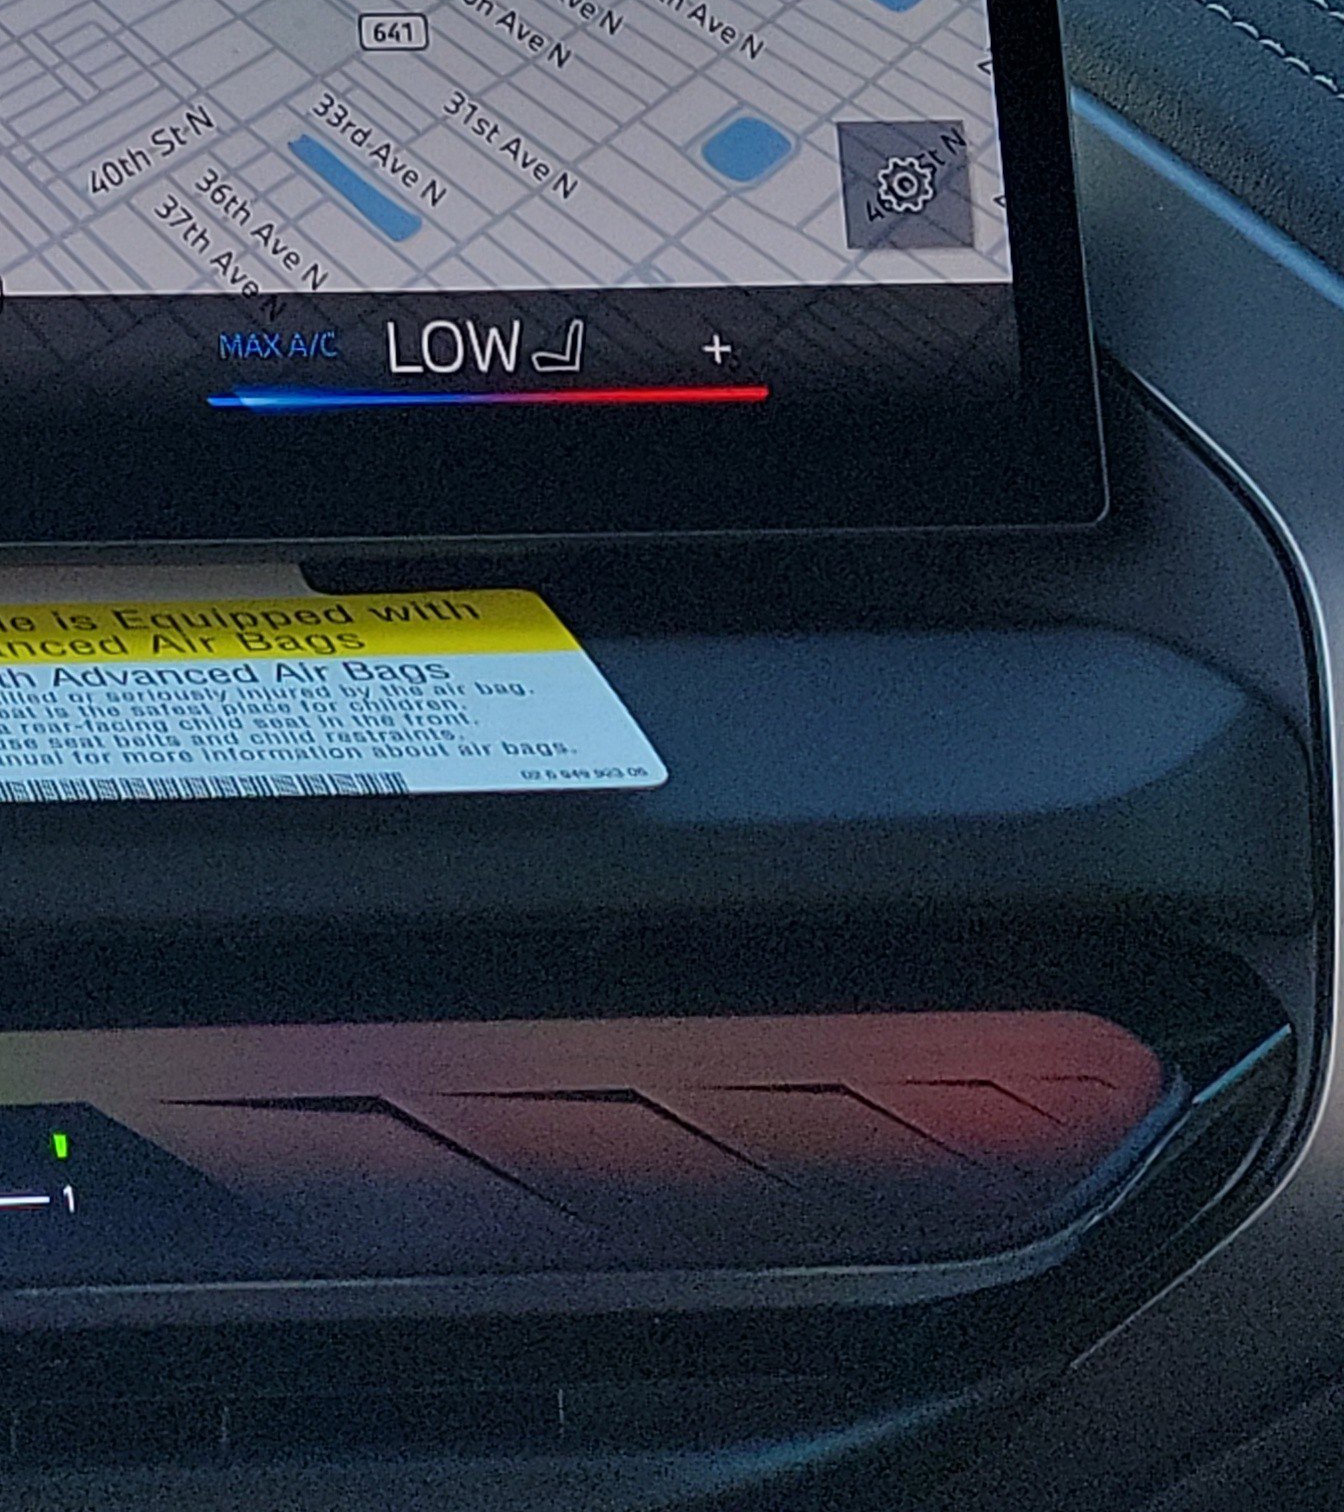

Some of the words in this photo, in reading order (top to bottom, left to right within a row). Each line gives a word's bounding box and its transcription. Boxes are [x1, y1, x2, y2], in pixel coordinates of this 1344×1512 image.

[373, 22, 414, 43] 641
[495, 6, 546, 55] Ave
[546, 43, 573, 70] N
[598, 11, 625, 37] N
[686, 4, 737, 45] Ave
[739, 33, 766, 60] N
[87, 149, 152, 198] 40th
[150, 128, 188, 160] St
[185, 104, 216, 134] N
[443, 91, 504, 145] 31st
[497, 133, 553, 184] Ave
[551, 170, 580, 200] N
[193, 167, 253, 226] 36th
[249, 219, 301, 272] Ave
[298, 261, 330, 292] N
[219, 331, 283, 359] MAX
[287, 331, 339, 358] A/C
[385, 319, 524, 375] LOW
[51, 610, 98, 632] is
[111, 602, 355, 635] Equipped
[367, 599, 481, 623] with
[152, 632, 217, 655] Air
[235, 630, 366, 655] Bags
[52, 663, 260, 688] Advanced
[276, 661, 330, 684] Air
[342, 660, 451, 684] Bags
[68, 692, 94, 704] or
[105, 686, 227, 704] seriously
[339, 683, 371, 700] by
[380, 683, 424, 697] the
[433, 683, 466, 696] air
